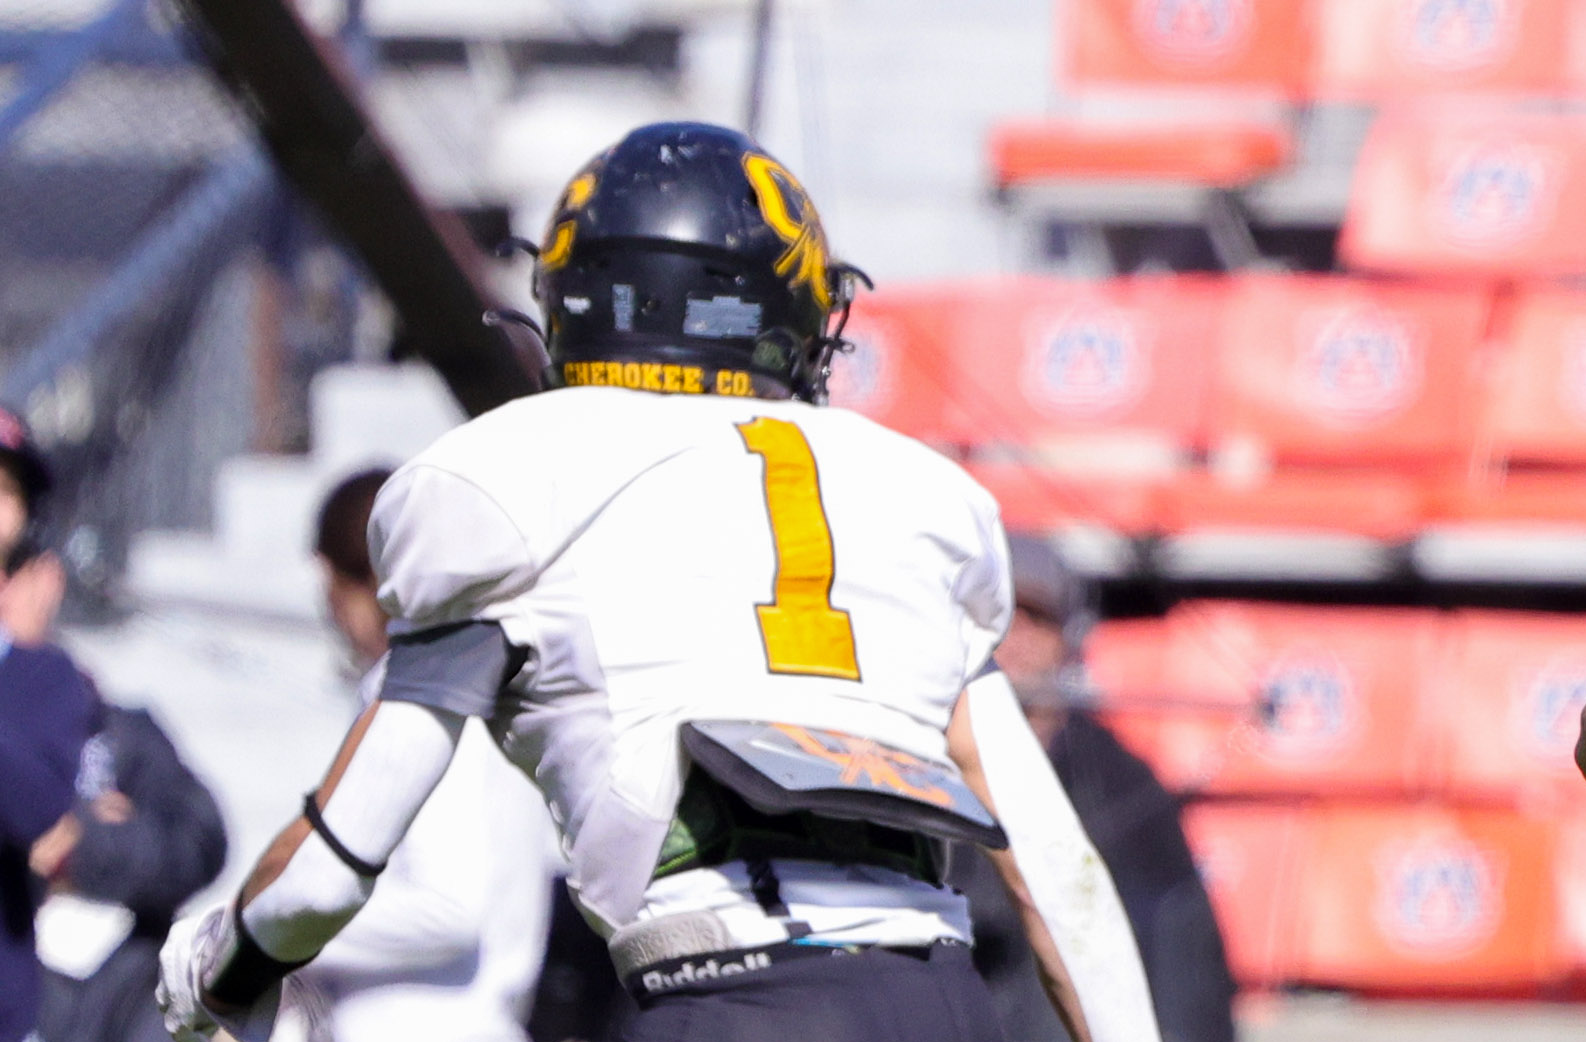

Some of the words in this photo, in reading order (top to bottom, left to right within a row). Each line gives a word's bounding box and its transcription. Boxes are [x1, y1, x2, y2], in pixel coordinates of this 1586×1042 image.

[564, 361, 704, 393] CHEROKEE
[716, 369, 756, 396] CO.
[733, 415, 863, 683] 1
